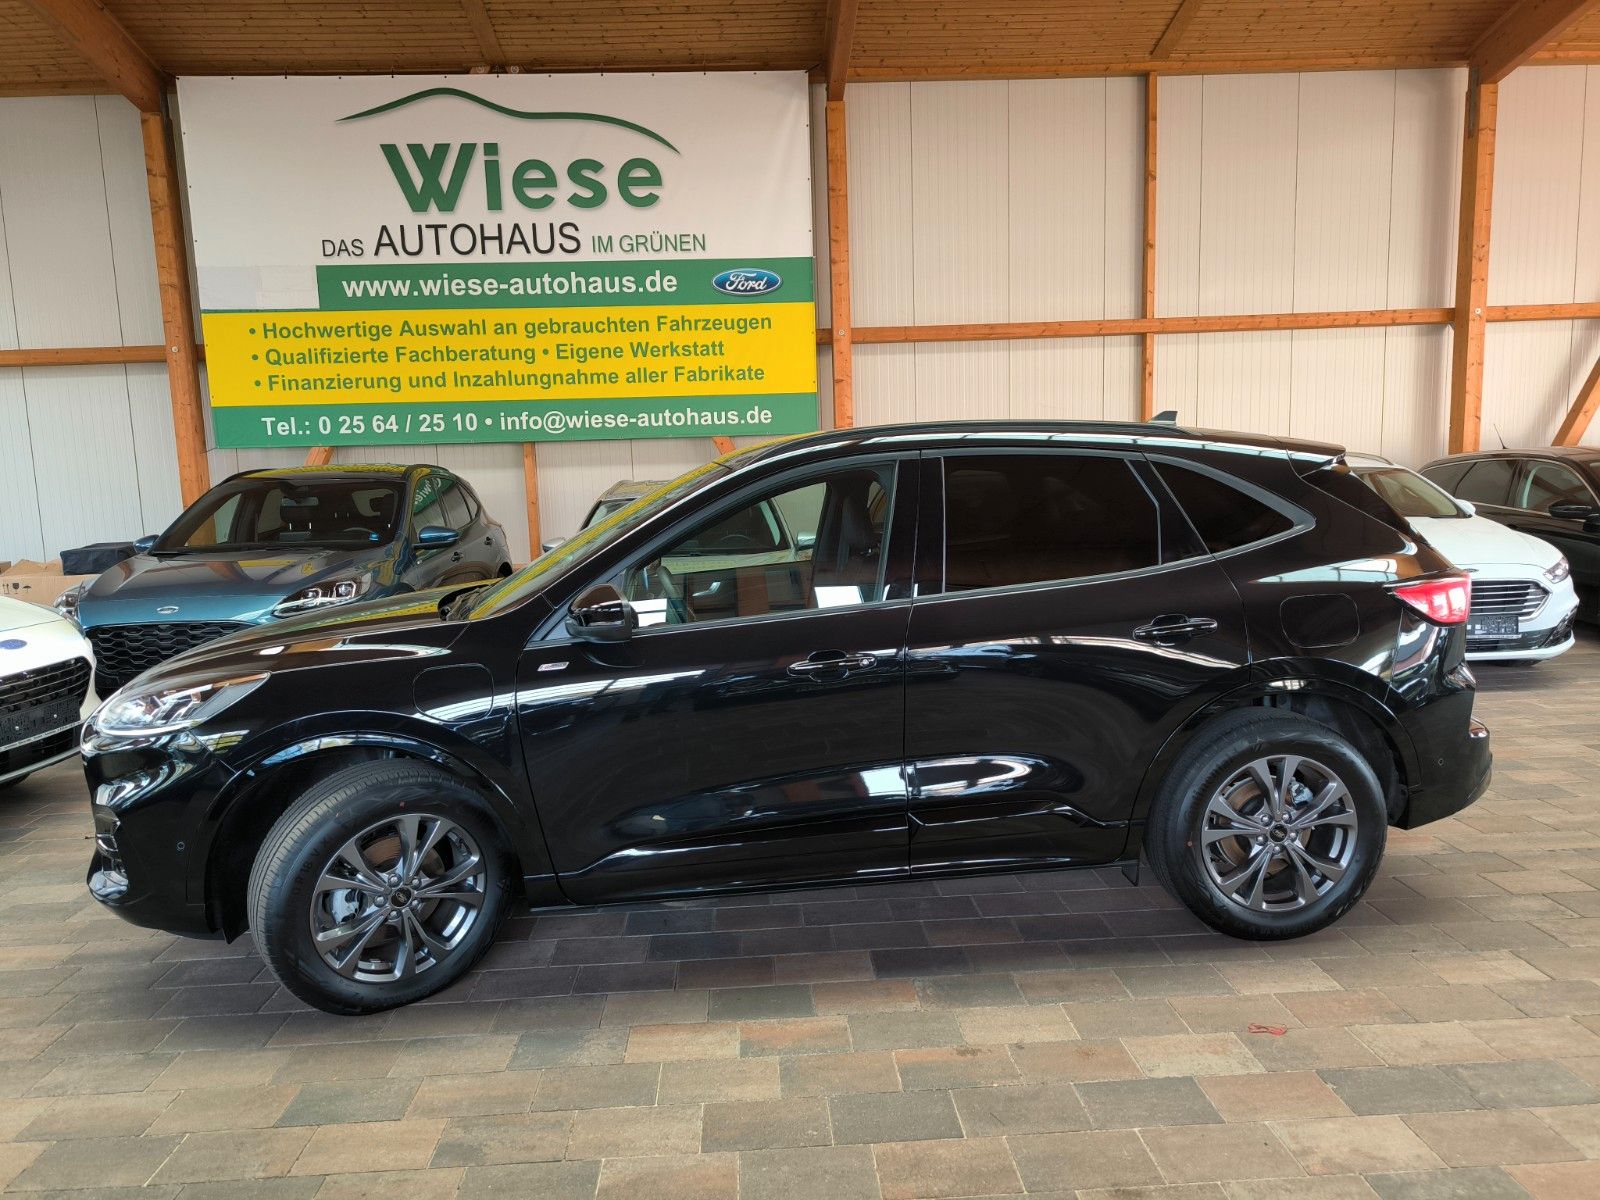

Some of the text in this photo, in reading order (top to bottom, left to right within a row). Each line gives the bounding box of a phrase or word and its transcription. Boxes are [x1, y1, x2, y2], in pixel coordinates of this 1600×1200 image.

[379, 142, 663, 212] Wiese
[322, 222, 706, 257] DAS AUTOHAUS IM GRÜNEN
[342, 270, 678, 297] www.wiese-autohaus.de
[725, 273, 768, 291] Ford
[262, 315, 772, 341] Hochwertige Auswahl an gebrauchten Fahrzeugen
[265, 341, 725, 366] Qualifizierte Fachberatung Eigene Werkstatt
[268, 363, 765, 393] Finanzierung und Inzahlungnahme aller Fabrikate
[261, 406, 773, 436] Tel.: 0 25 64 / 25 10 info@wiese-autohaus.de
